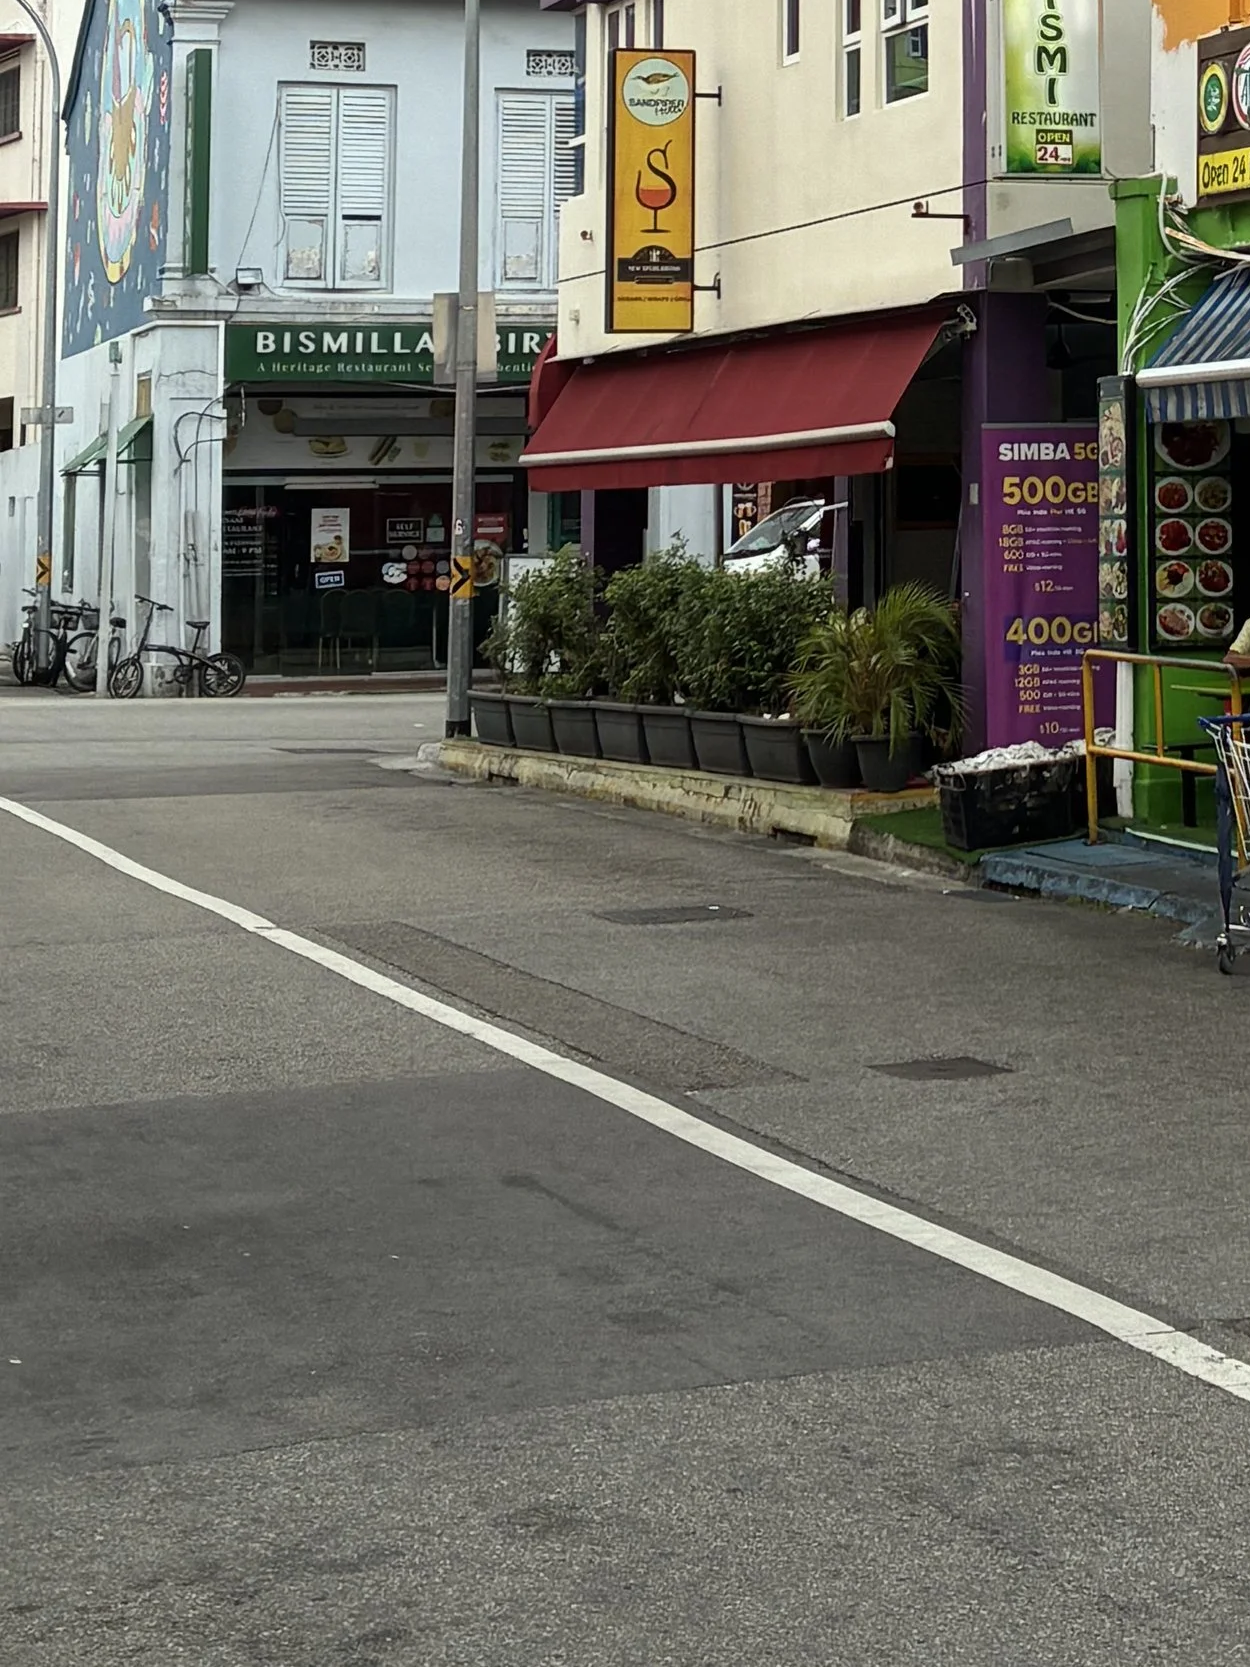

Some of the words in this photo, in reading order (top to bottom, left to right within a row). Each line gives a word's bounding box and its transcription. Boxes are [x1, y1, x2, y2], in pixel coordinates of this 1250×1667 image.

[1011, 111, 1097, 127] RESTAURANT
[1038, 132, 1070, 143] OPEN
[1037, 145, 1061, 162] 24
[1232, 154, 1246, 183] 24
[256, 331, 434, 354] BISMILLA
[257, 364, 266, 373] A
[271, 362, 331, 374] Heritage
[337, 362, 412, 373] Restaurant
[998, 442, 1071, 461] SIMBA
[1002, 475, 1098, 506] 500GB
[1006, 616, 1098, 645] 400G
